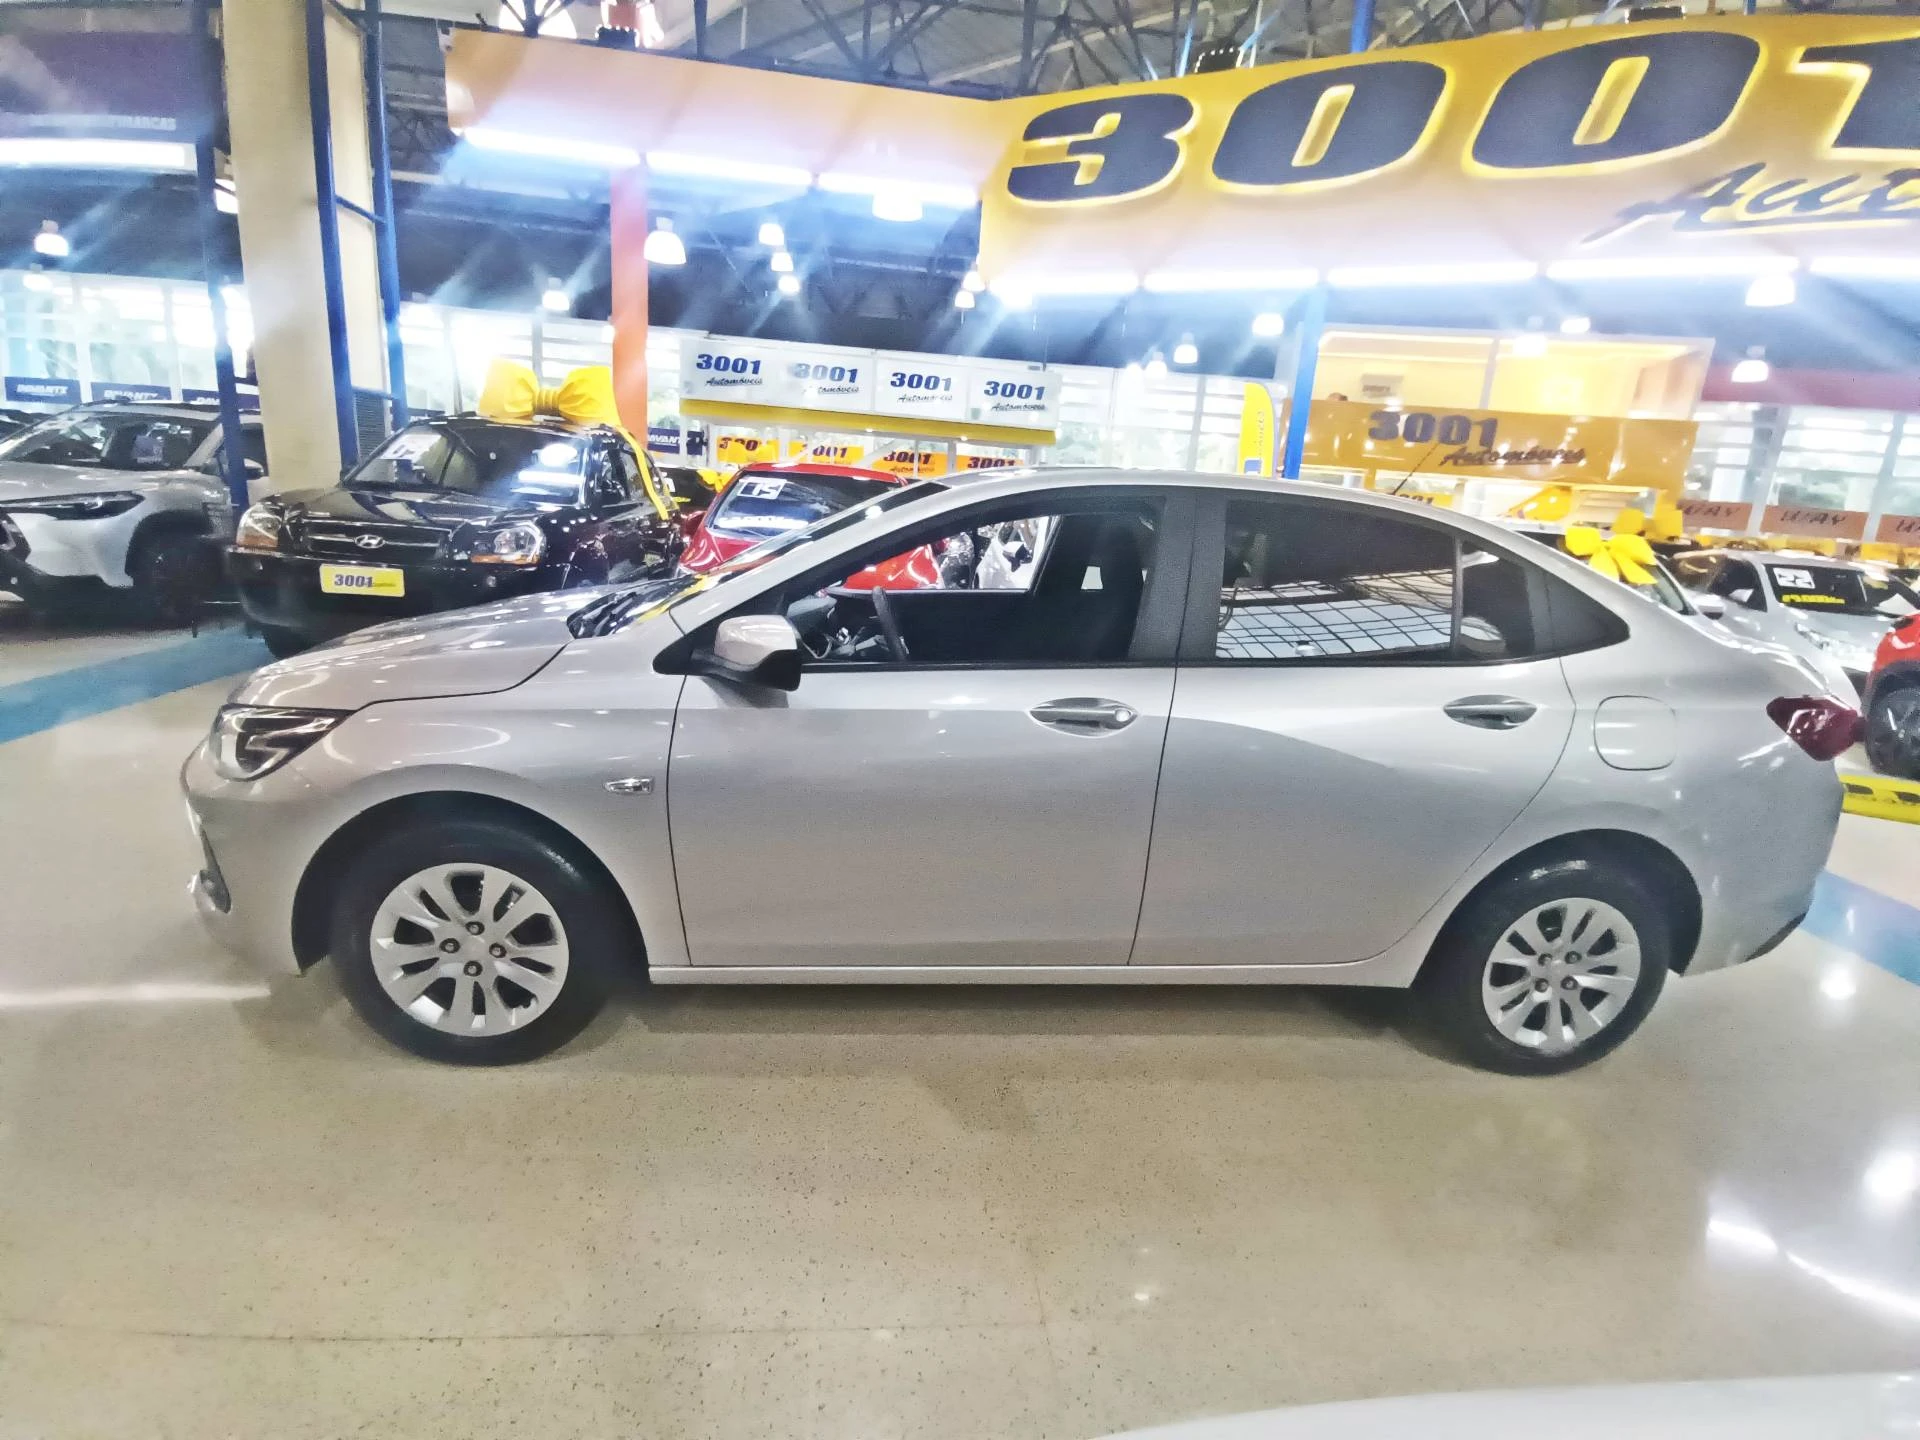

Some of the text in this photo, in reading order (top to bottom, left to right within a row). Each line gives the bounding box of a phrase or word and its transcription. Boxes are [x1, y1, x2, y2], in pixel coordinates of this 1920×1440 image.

[696, 353, 762, 375] 3001
[790, 362, 859, 384] 3001
[890, 372, 953, 392] 3001
[983, 380, 1046, 401] 3001
[1368, 411, 1498, 449] 3001
[334, 574, 373, 588] 3001
